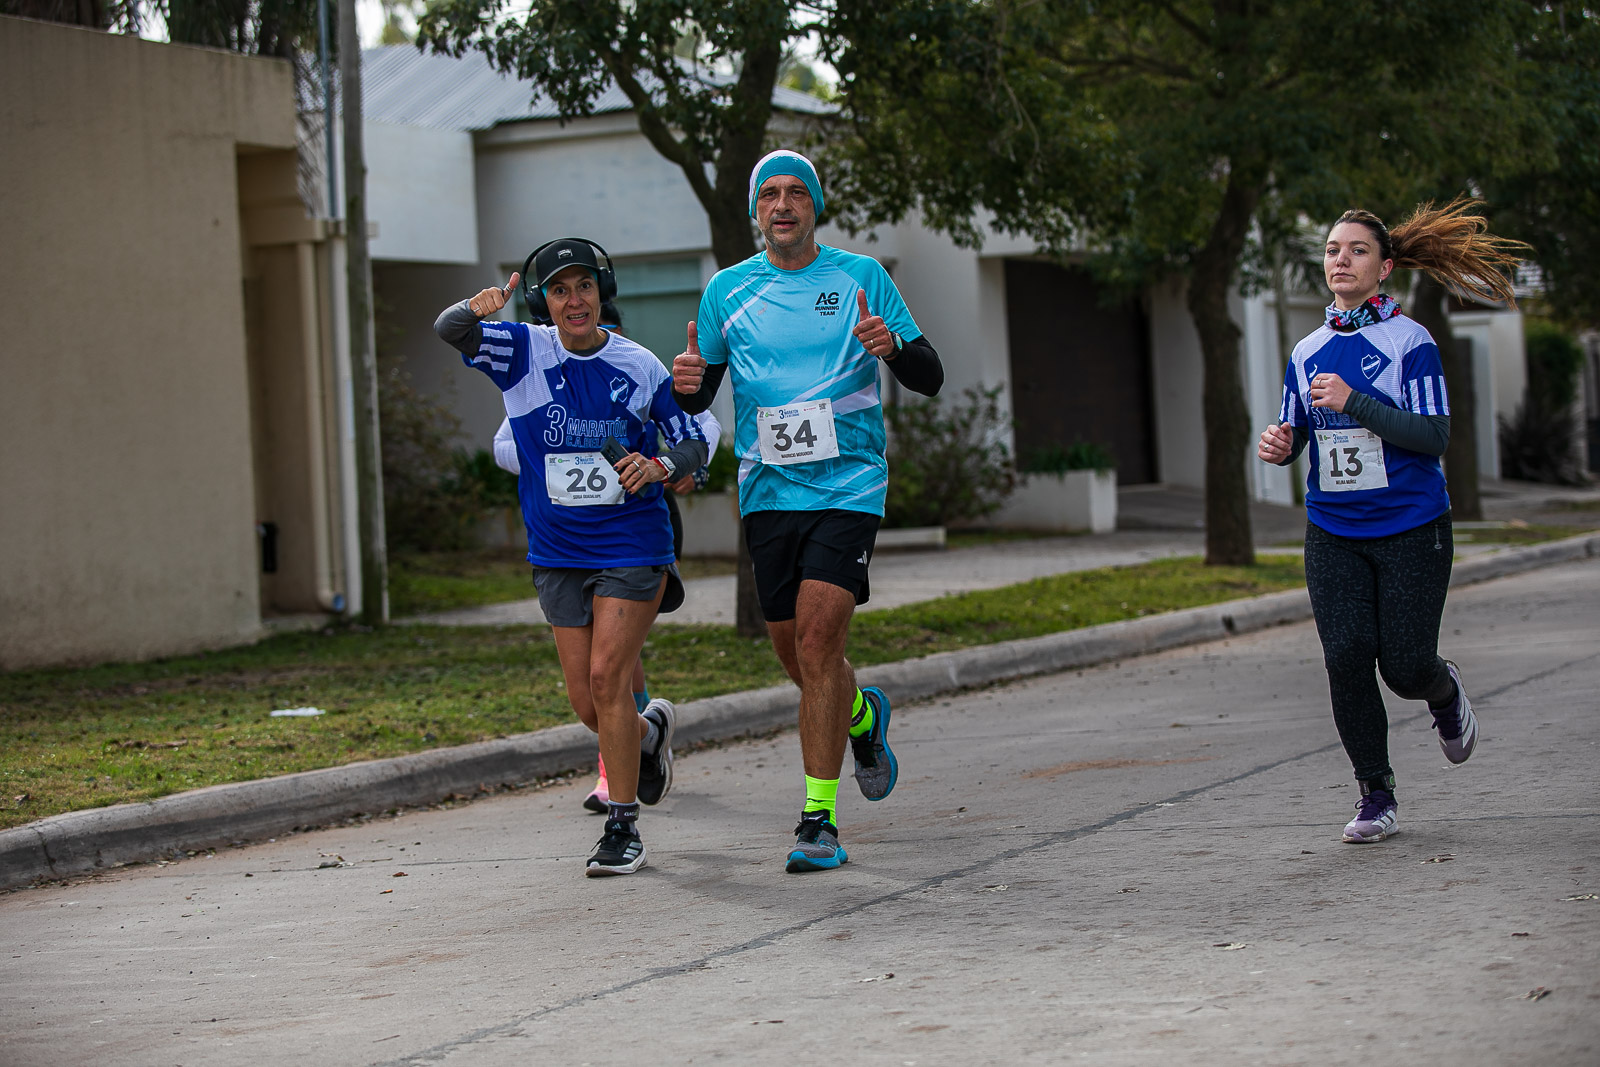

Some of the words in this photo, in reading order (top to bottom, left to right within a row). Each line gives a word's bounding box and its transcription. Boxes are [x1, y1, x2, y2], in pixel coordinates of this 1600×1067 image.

[815, 292, 839, 305] AG
[543, 404, 567, 447] 3
[566, 417, 628, 437] MARATÓN
[771, 419, 817, 451] 34
[1329, 447, 1363, 477] 13
[566, 467, 607, 492] 26
